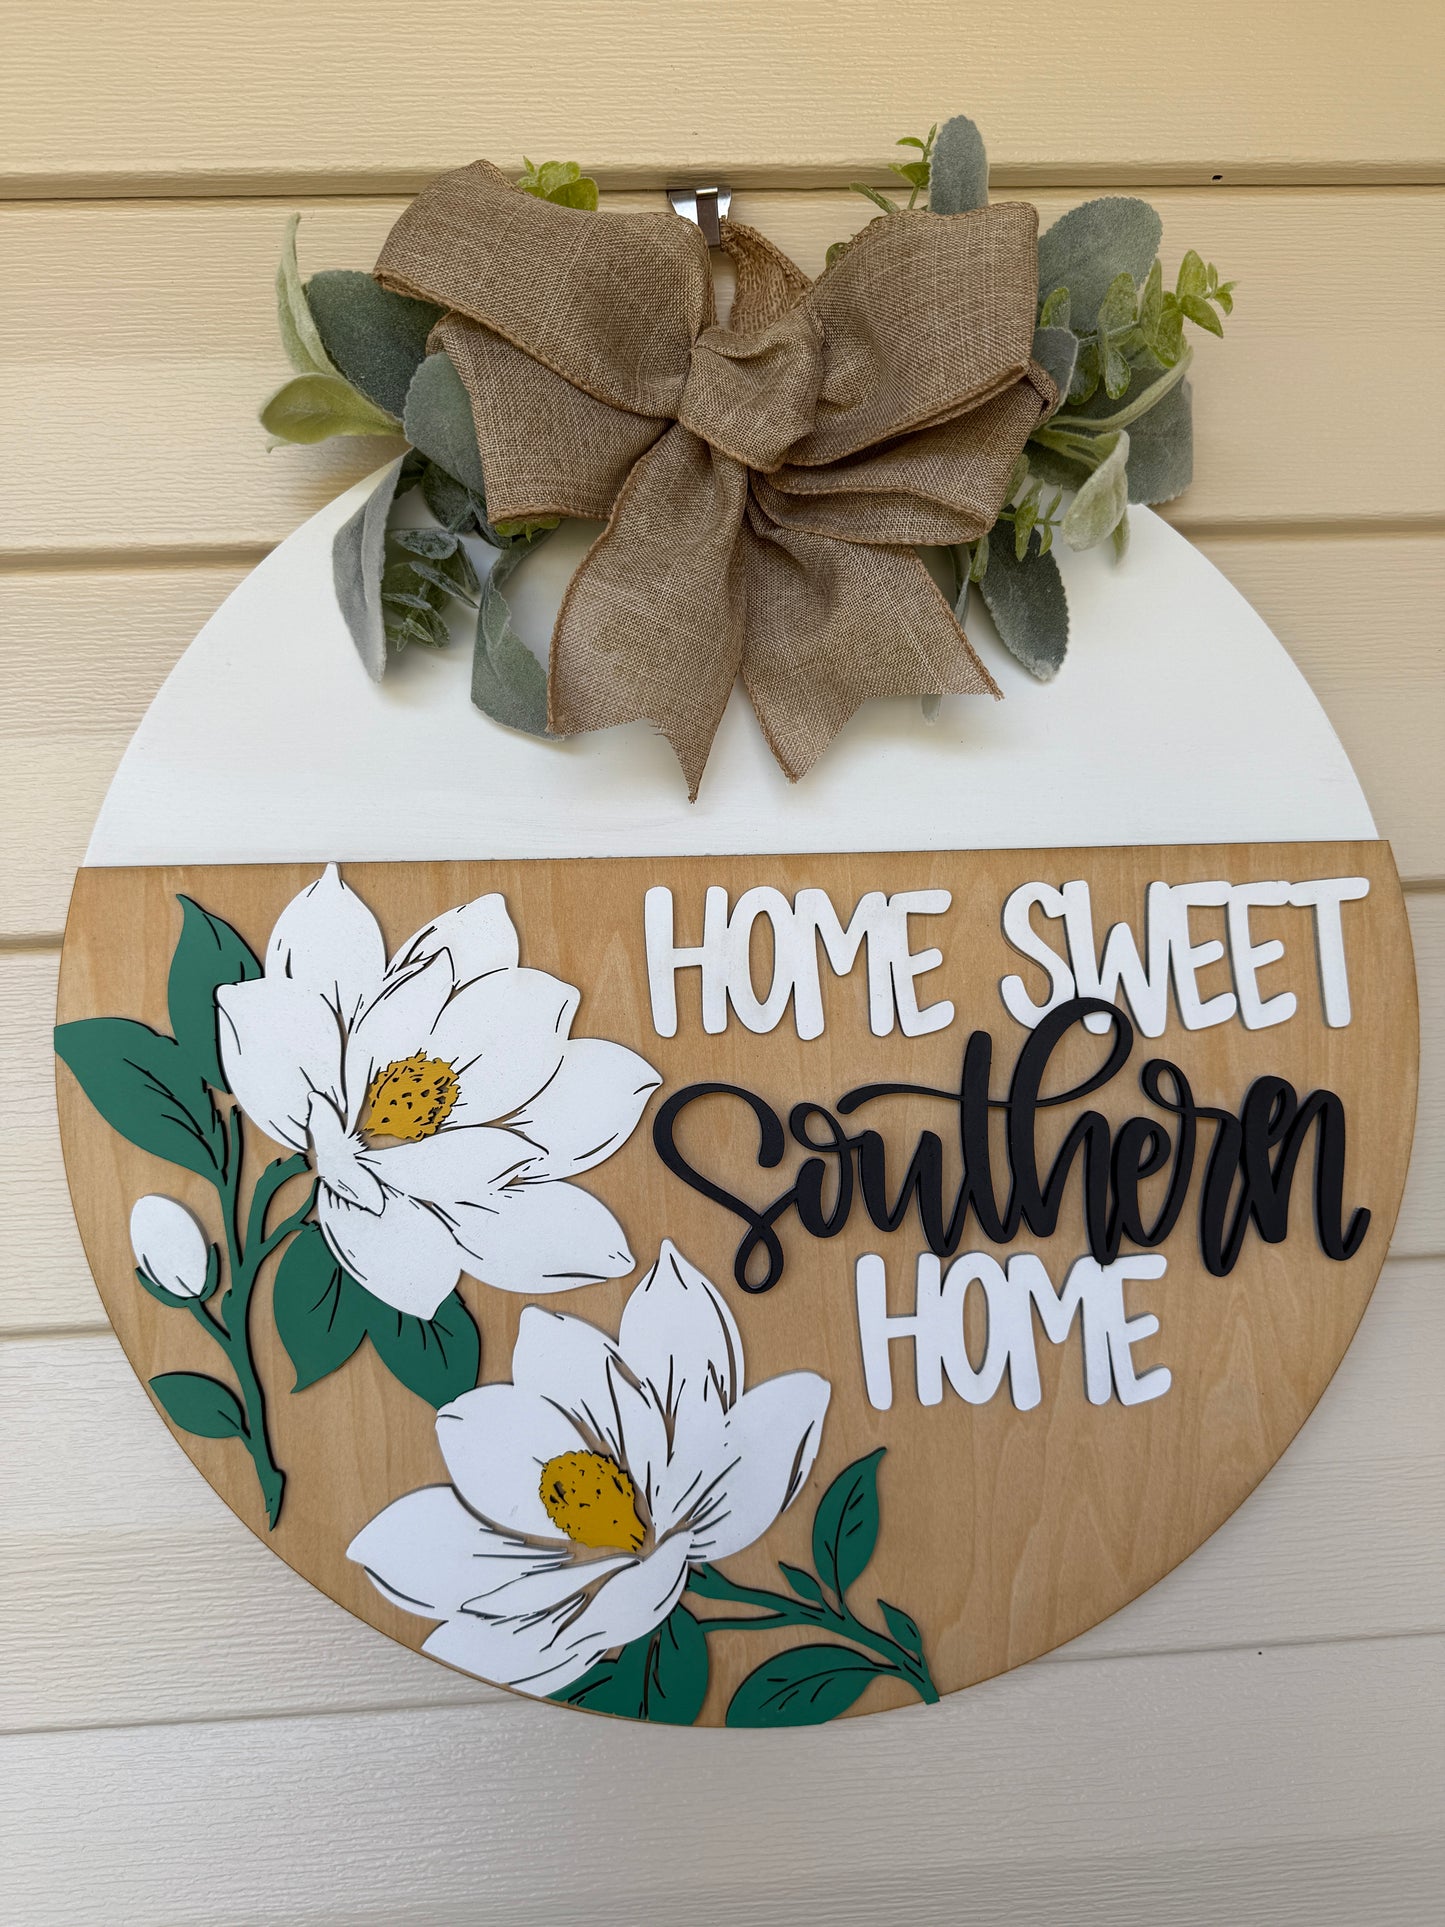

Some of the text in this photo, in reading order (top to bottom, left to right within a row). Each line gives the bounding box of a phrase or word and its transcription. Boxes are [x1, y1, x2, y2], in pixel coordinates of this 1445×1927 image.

[644, 877, 1370, 1040] HOME SWEET
[855, 1252, 1172, 1411] HOME
